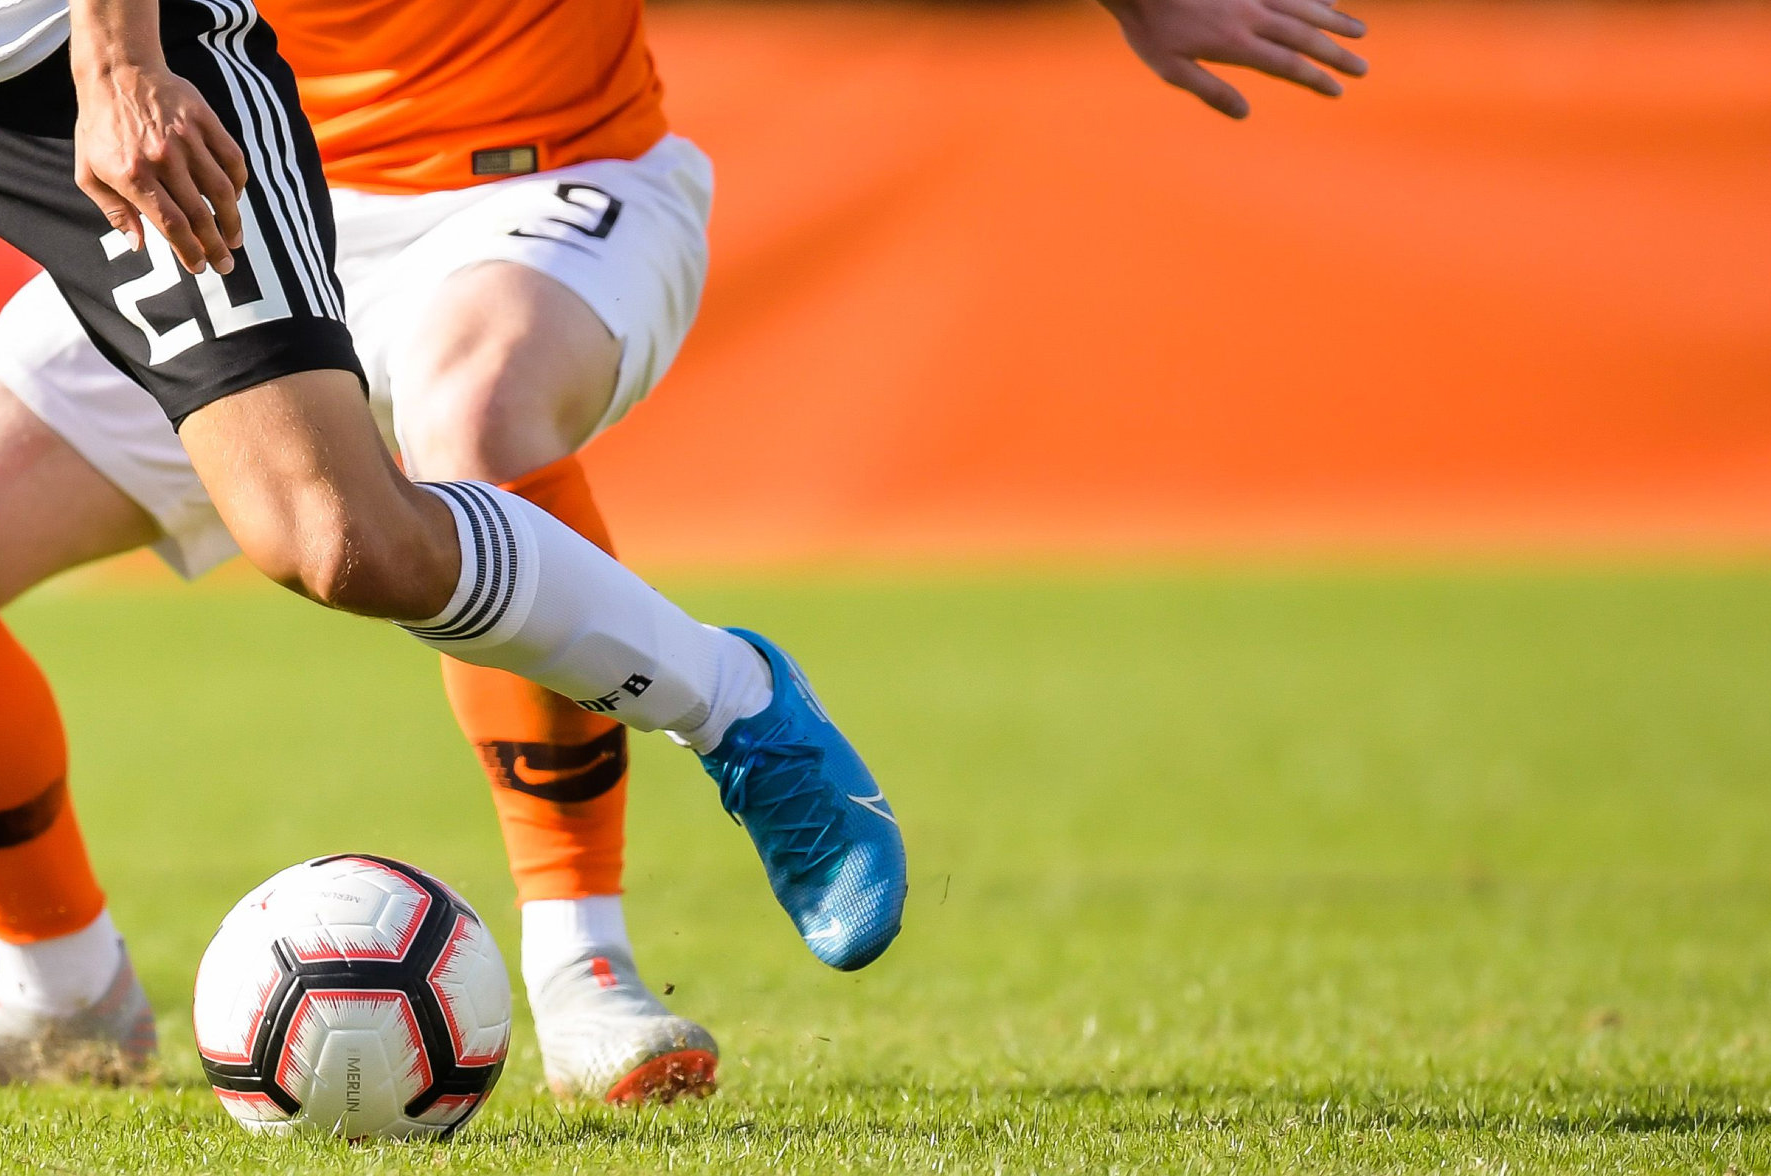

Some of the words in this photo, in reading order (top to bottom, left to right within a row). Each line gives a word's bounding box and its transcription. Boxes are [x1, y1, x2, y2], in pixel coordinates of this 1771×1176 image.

[99, 187, 293, 366] 20
[574, 672, 654, 713] DFB
[346, 1057, 361, 1112] MERLIN
